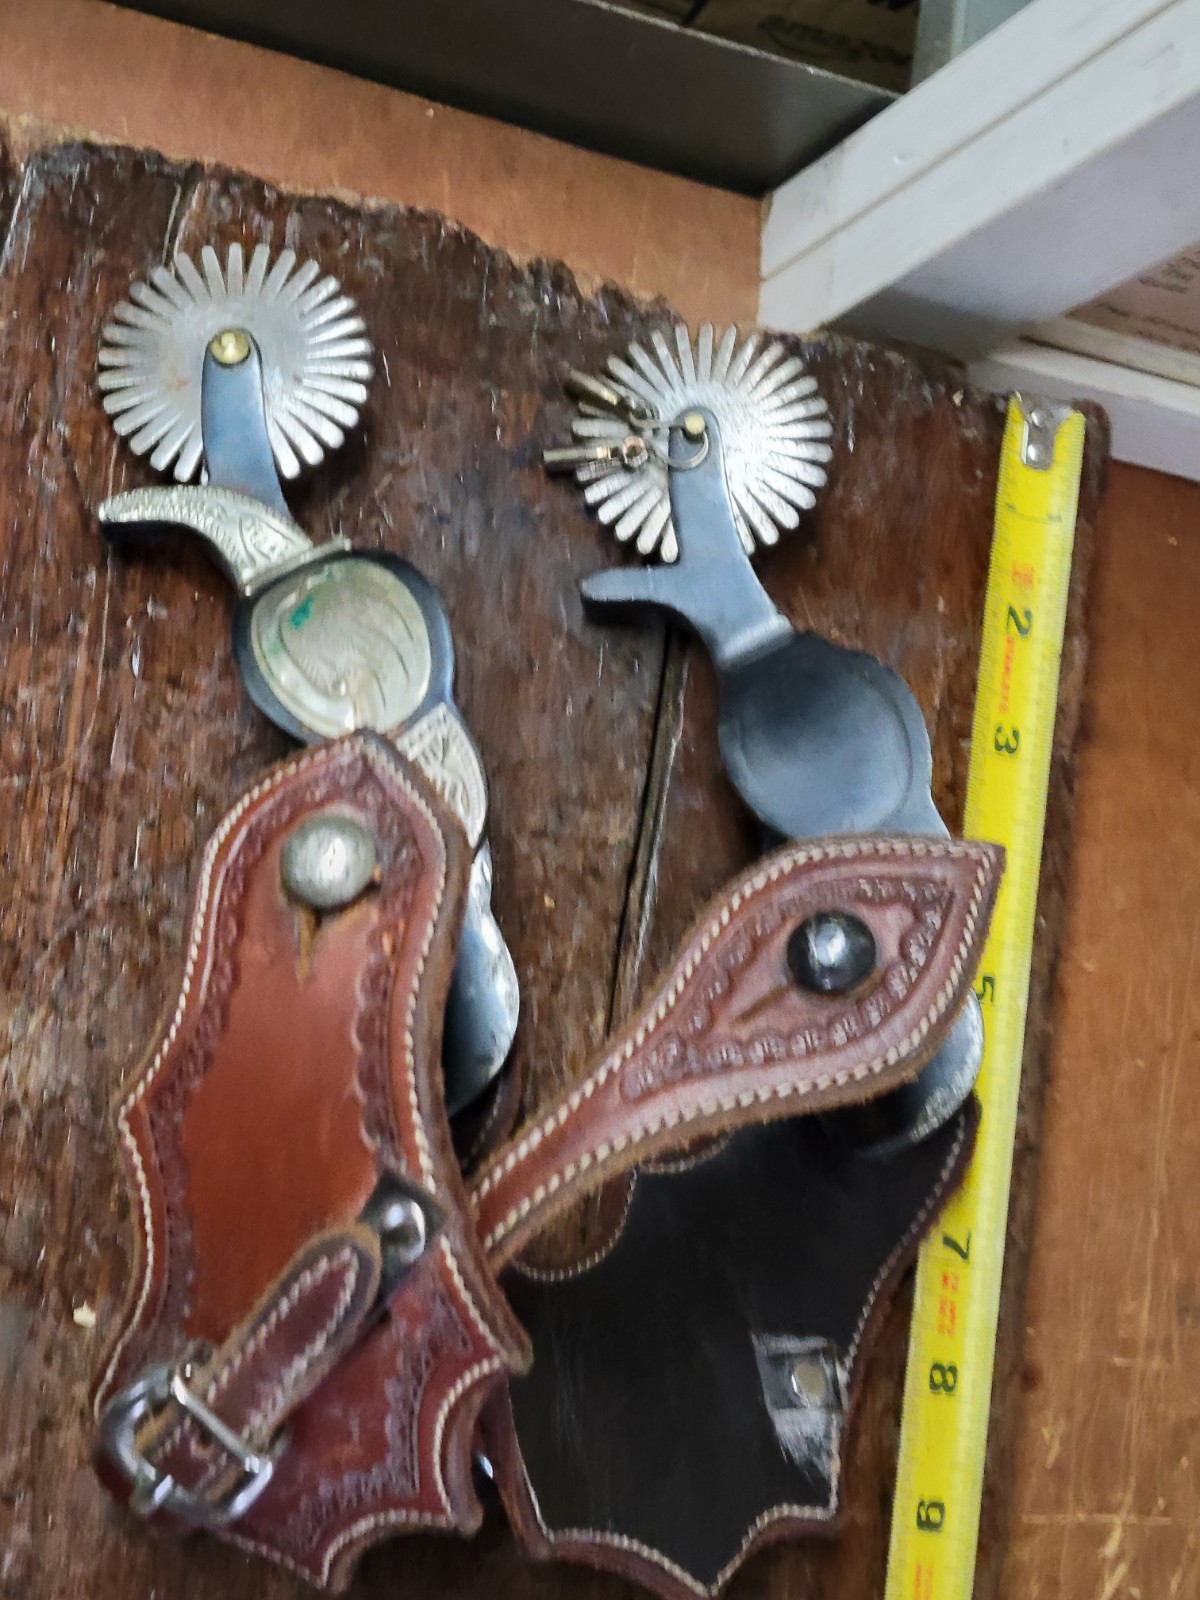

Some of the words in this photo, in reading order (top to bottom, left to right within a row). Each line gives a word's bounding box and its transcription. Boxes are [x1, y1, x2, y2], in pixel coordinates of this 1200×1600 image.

[1007, 604, 1032, 640] 2
[994, 725, 1021, 757] 3
[941, 1231, 971, 1263] 7
[928, 1361, 959, 1395] 8
[915, 1498, 946, 1533] 9
